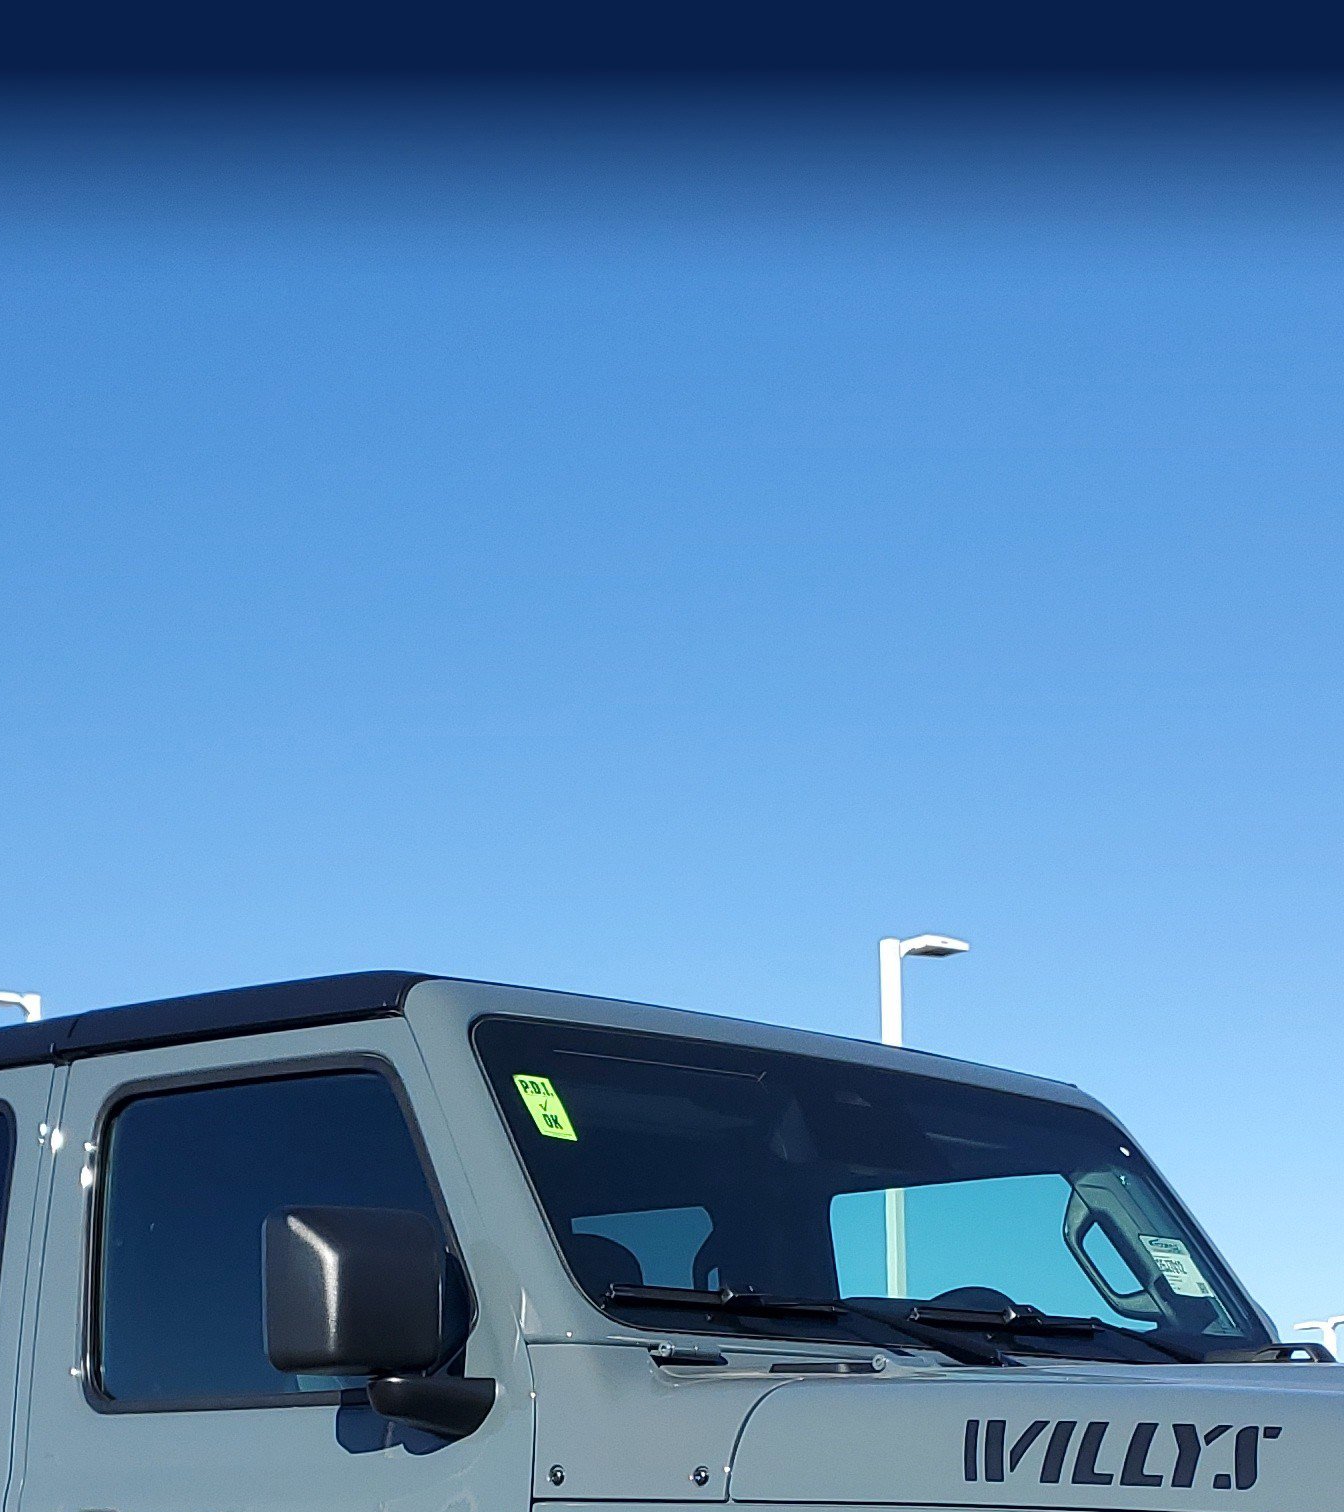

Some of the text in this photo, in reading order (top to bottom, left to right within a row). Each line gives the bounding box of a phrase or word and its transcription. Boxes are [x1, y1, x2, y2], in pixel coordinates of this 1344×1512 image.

[518, 1079, 554, 1096] P.D.I.
[542, 1114, 564, 1130] OK
[963, 1419, 1283, 1491] WILLYS
